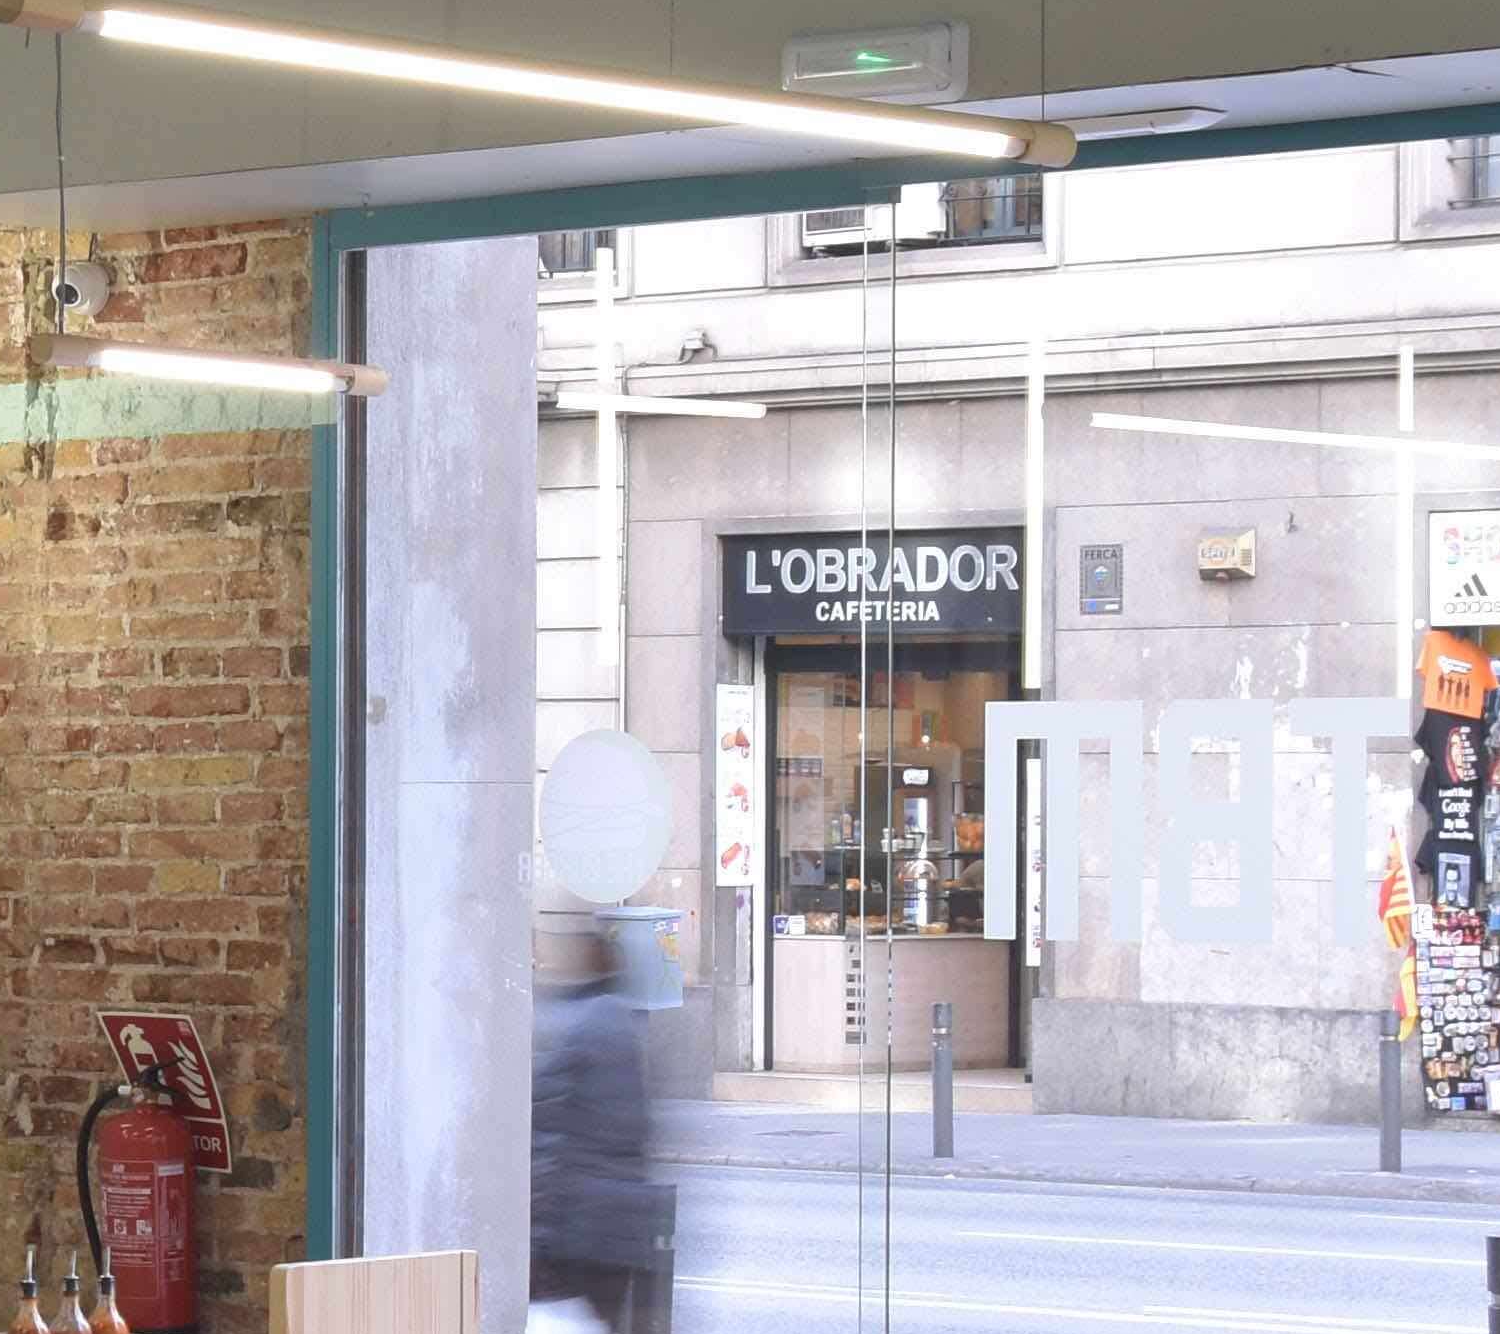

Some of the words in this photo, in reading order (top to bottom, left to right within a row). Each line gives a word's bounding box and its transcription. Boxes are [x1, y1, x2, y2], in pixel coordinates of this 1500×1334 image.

[745, 544, 1019, 595] L'OBRADOR
[815, 600, 940, 622] CAFETERIA
[192, 1135, 222, 1154] TOR
